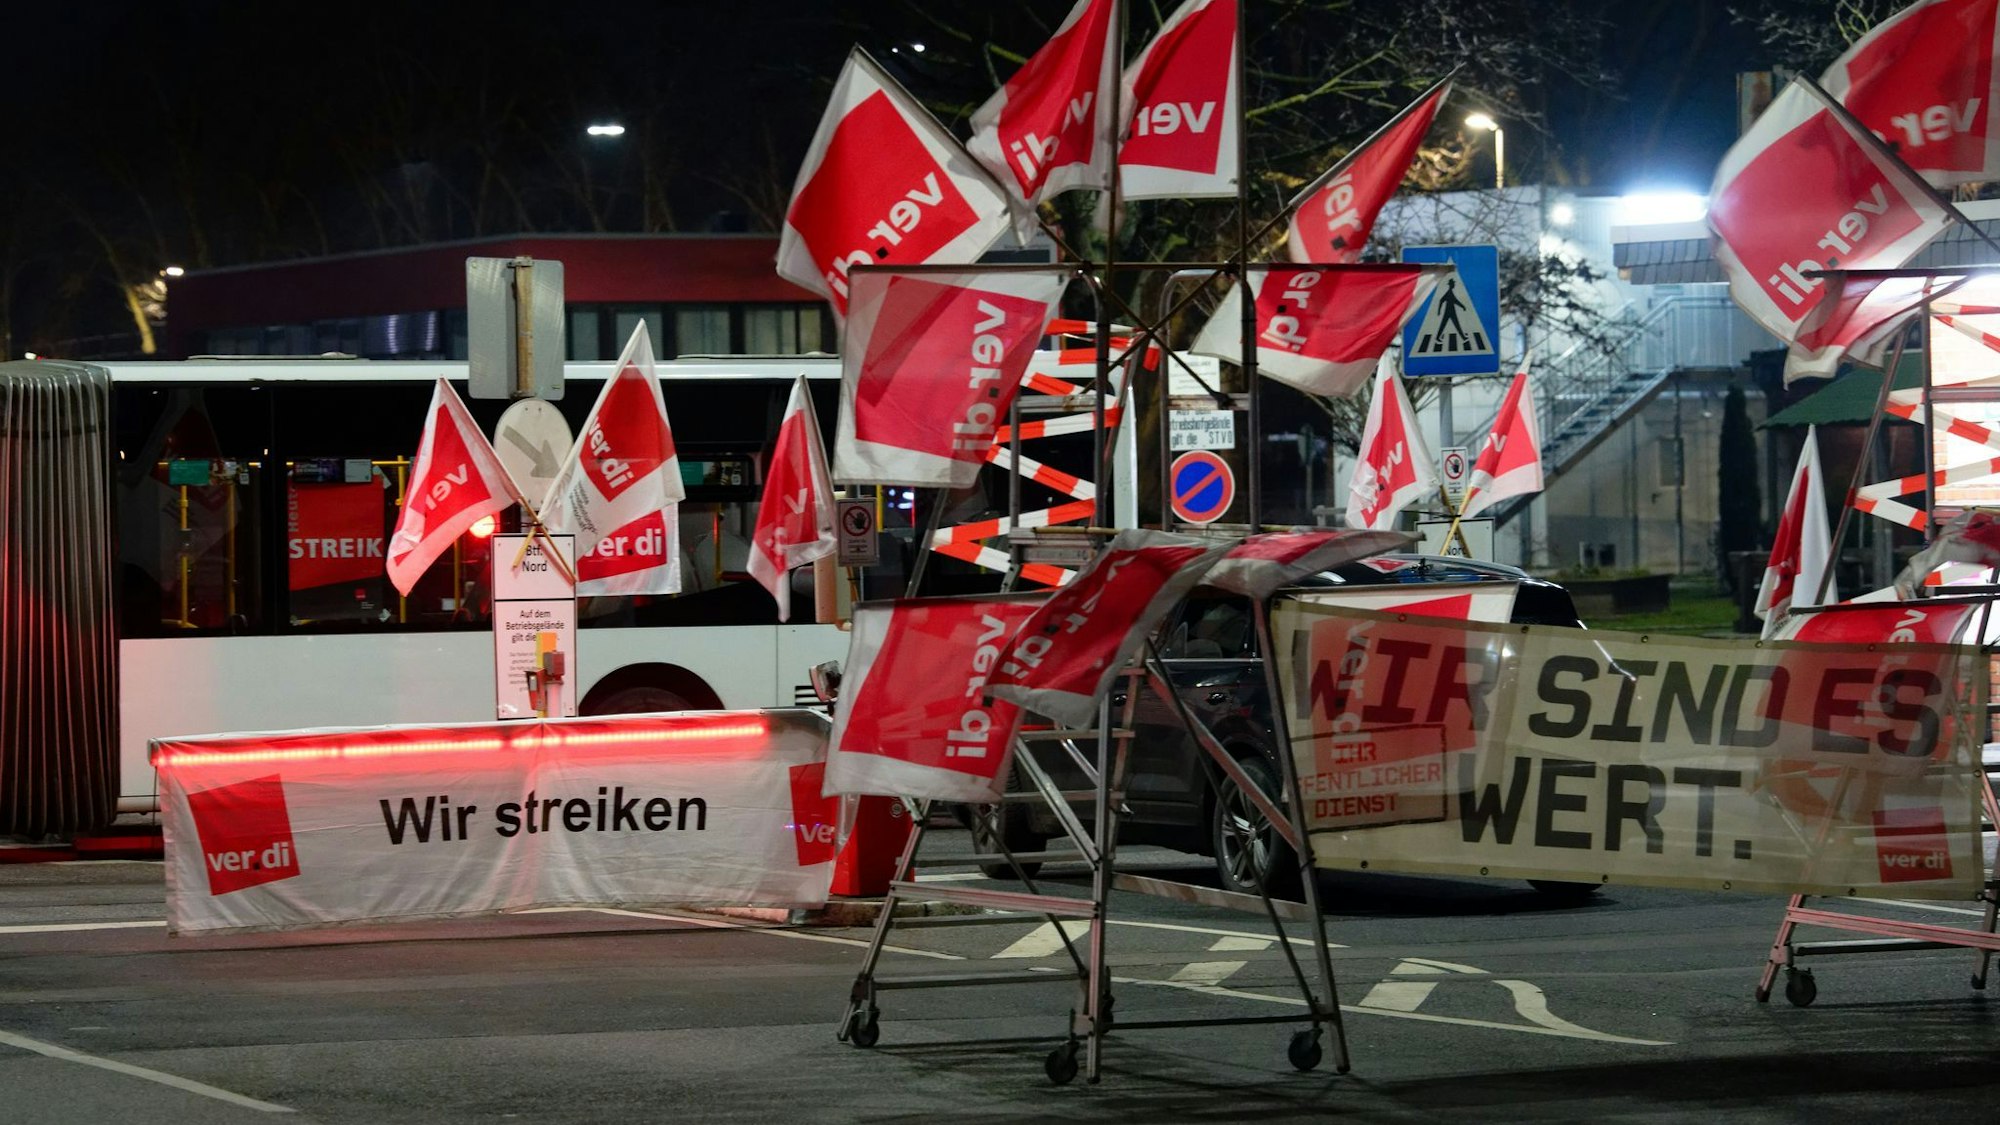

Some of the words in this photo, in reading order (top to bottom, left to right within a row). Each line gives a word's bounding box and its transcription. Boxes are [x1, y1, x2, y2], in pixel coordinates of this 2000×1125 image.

[289, 538, 383, 559] STREIK
[522, 560, 548, 572] Nord
[520, 609, 534, 619] Auf
[534, 609, 551, 619] dem
[506, 621, 565, 632] Betriebsgelände
[1292, 629, 1499, 731] WIR
[1528, 654, 1791, 748] SIND
[1812, 668, 1942, 757] ES
[1334, 742, 1377, 764] IHR
[380, 794, 477, 845] Wir
[496, 784, 707, 838] streiken
[1315, 791, 1400, 819] DIENST
[1459, 753, 1752, 860] WERT.
[208, 841, 291, 872] ver.di
[1883, 850, 1945, 869] ver.di
